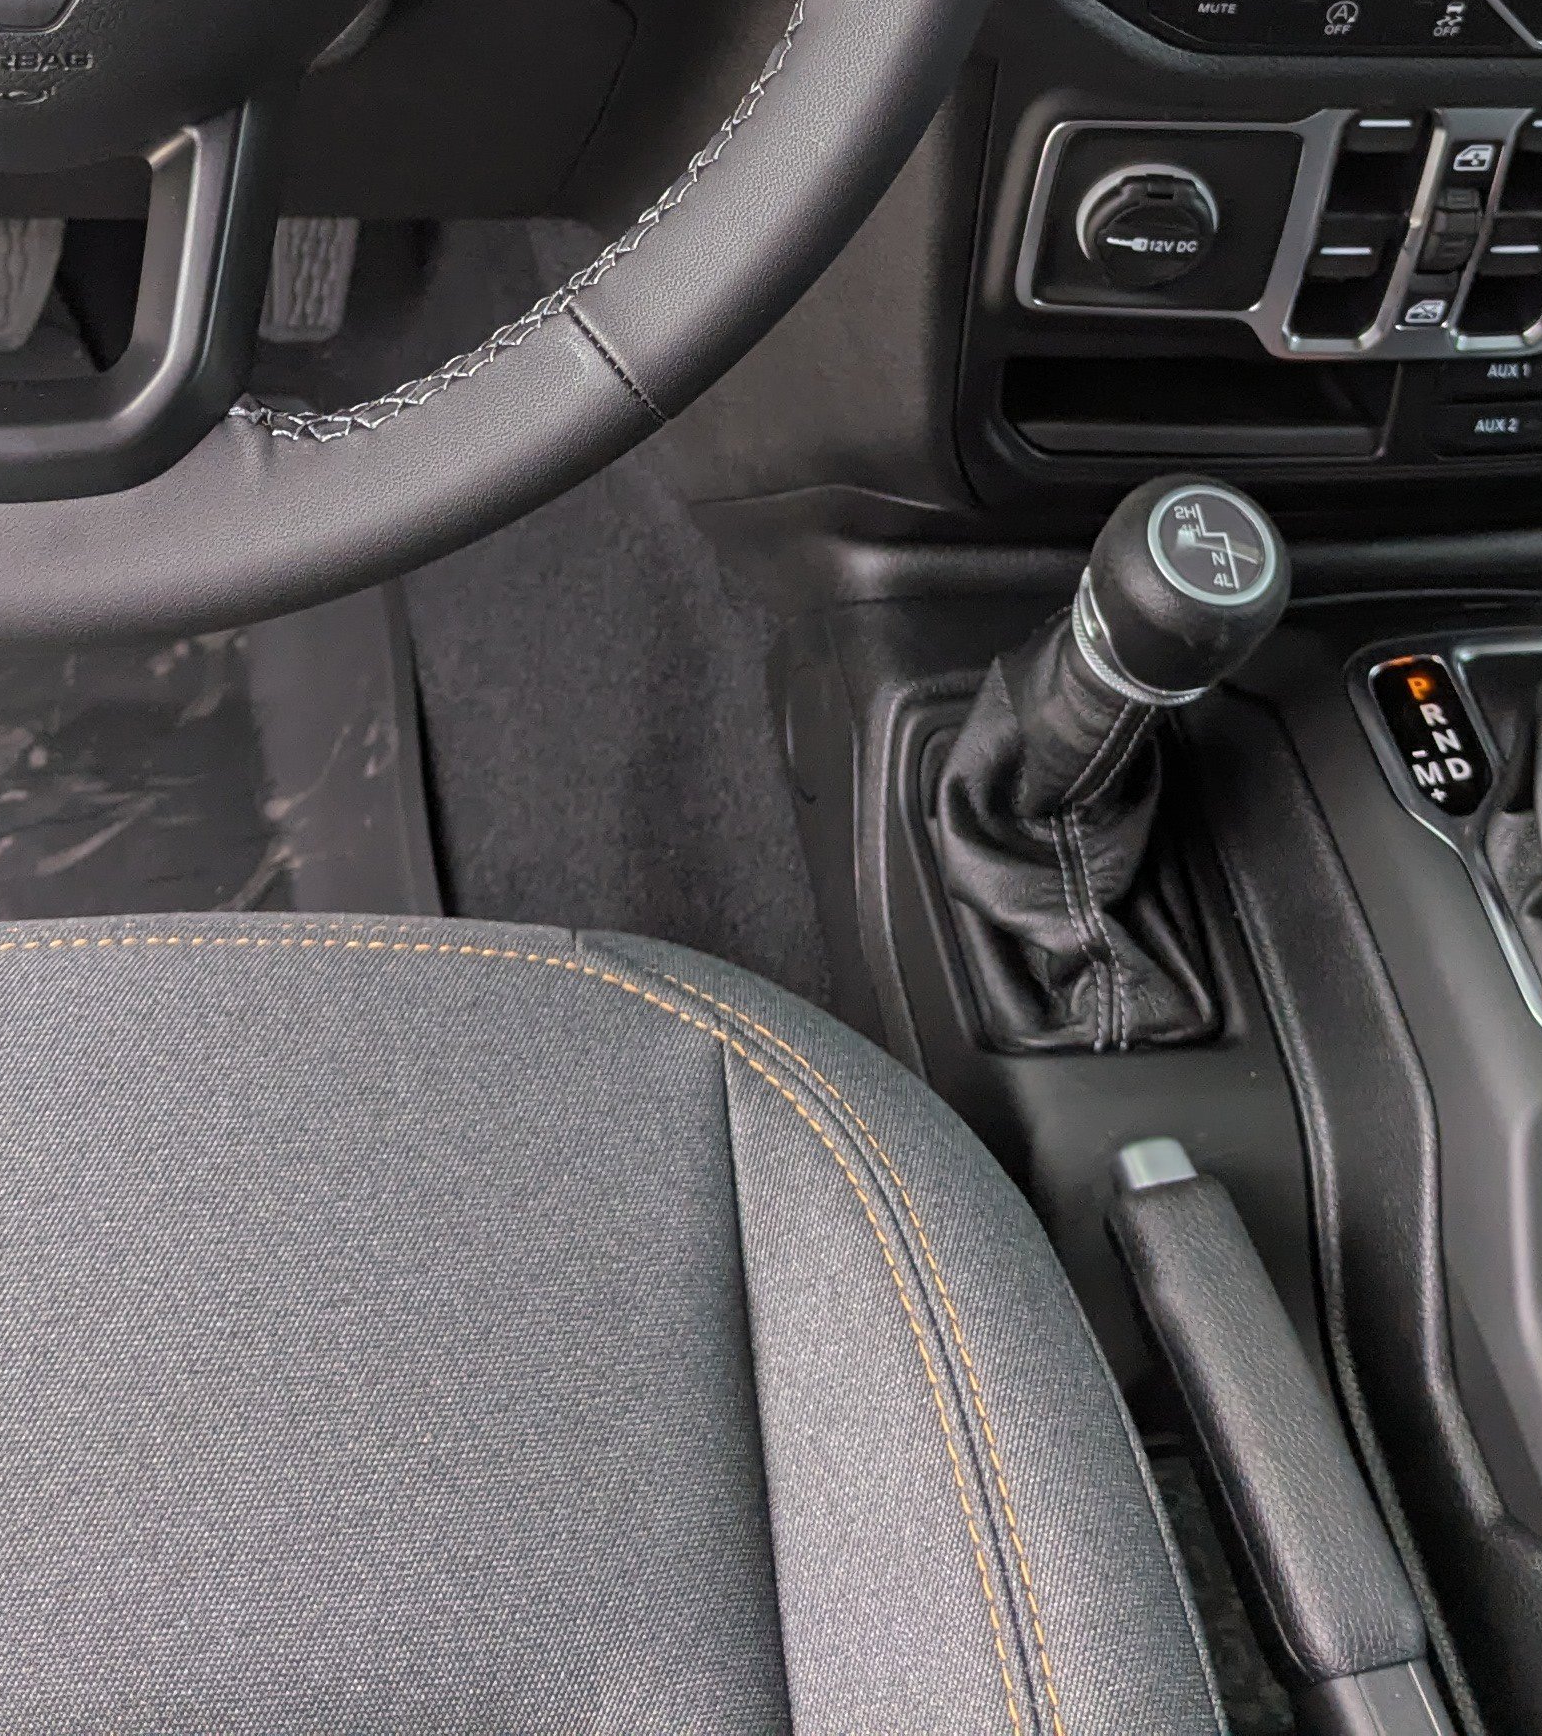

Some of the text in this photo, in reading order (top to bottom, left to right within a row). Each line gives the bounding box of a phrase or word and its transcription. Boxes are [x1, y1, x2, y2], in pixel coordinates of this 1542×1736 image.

[1198, 3, 1236, 14] MUTE
[1149, 240, 1174, 252] 12V
[1487, 363, 1518, 378] AUX
[1474, 418, 1505, 433] AUX
[1406, 675, 1436, 701] P
[1419, 703, 1448, 726] R
[1432, 730, 1461, 754] N
[1445, 757, 1472, 782] D
